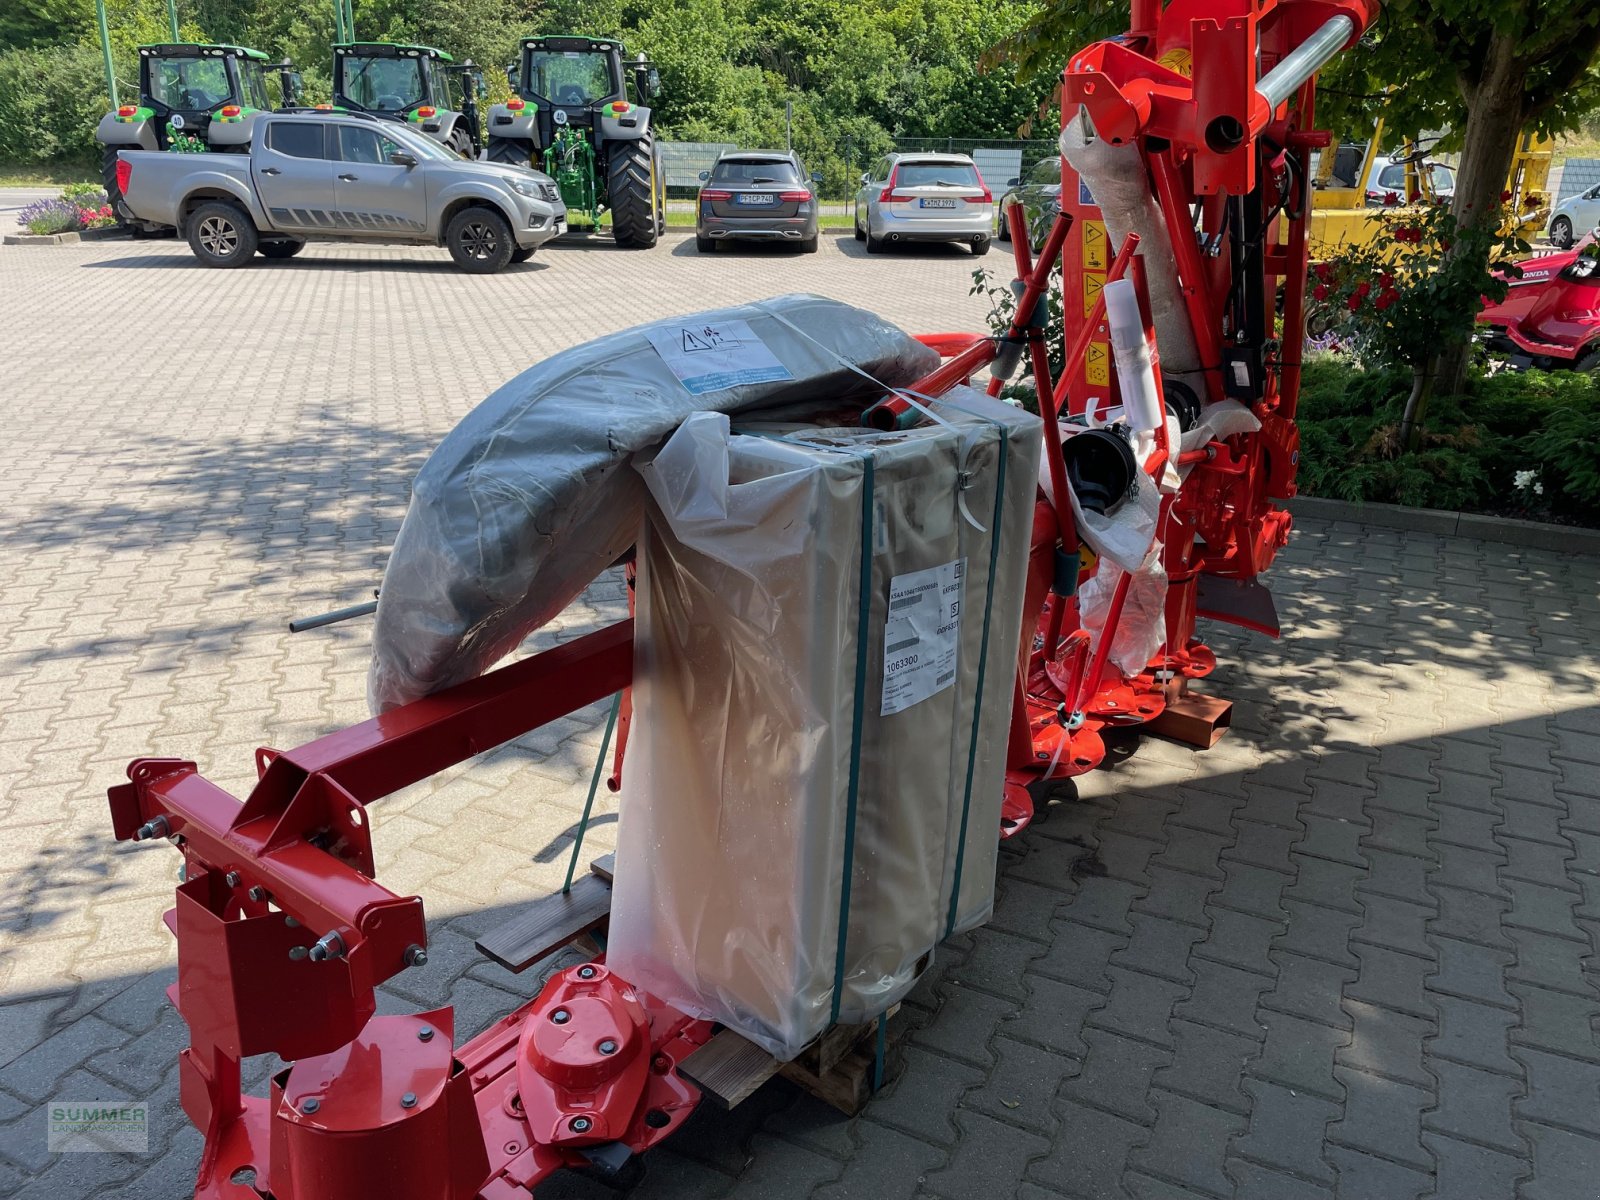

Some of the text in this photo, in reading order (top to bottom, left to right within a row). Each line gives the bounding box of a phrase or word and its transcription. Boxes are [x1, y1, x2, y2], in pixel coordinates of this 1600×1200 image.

[173, 116, 182, 126] 40
[555, 112, 565, 122] 40
[887, 654, 918, 673] 1063300
